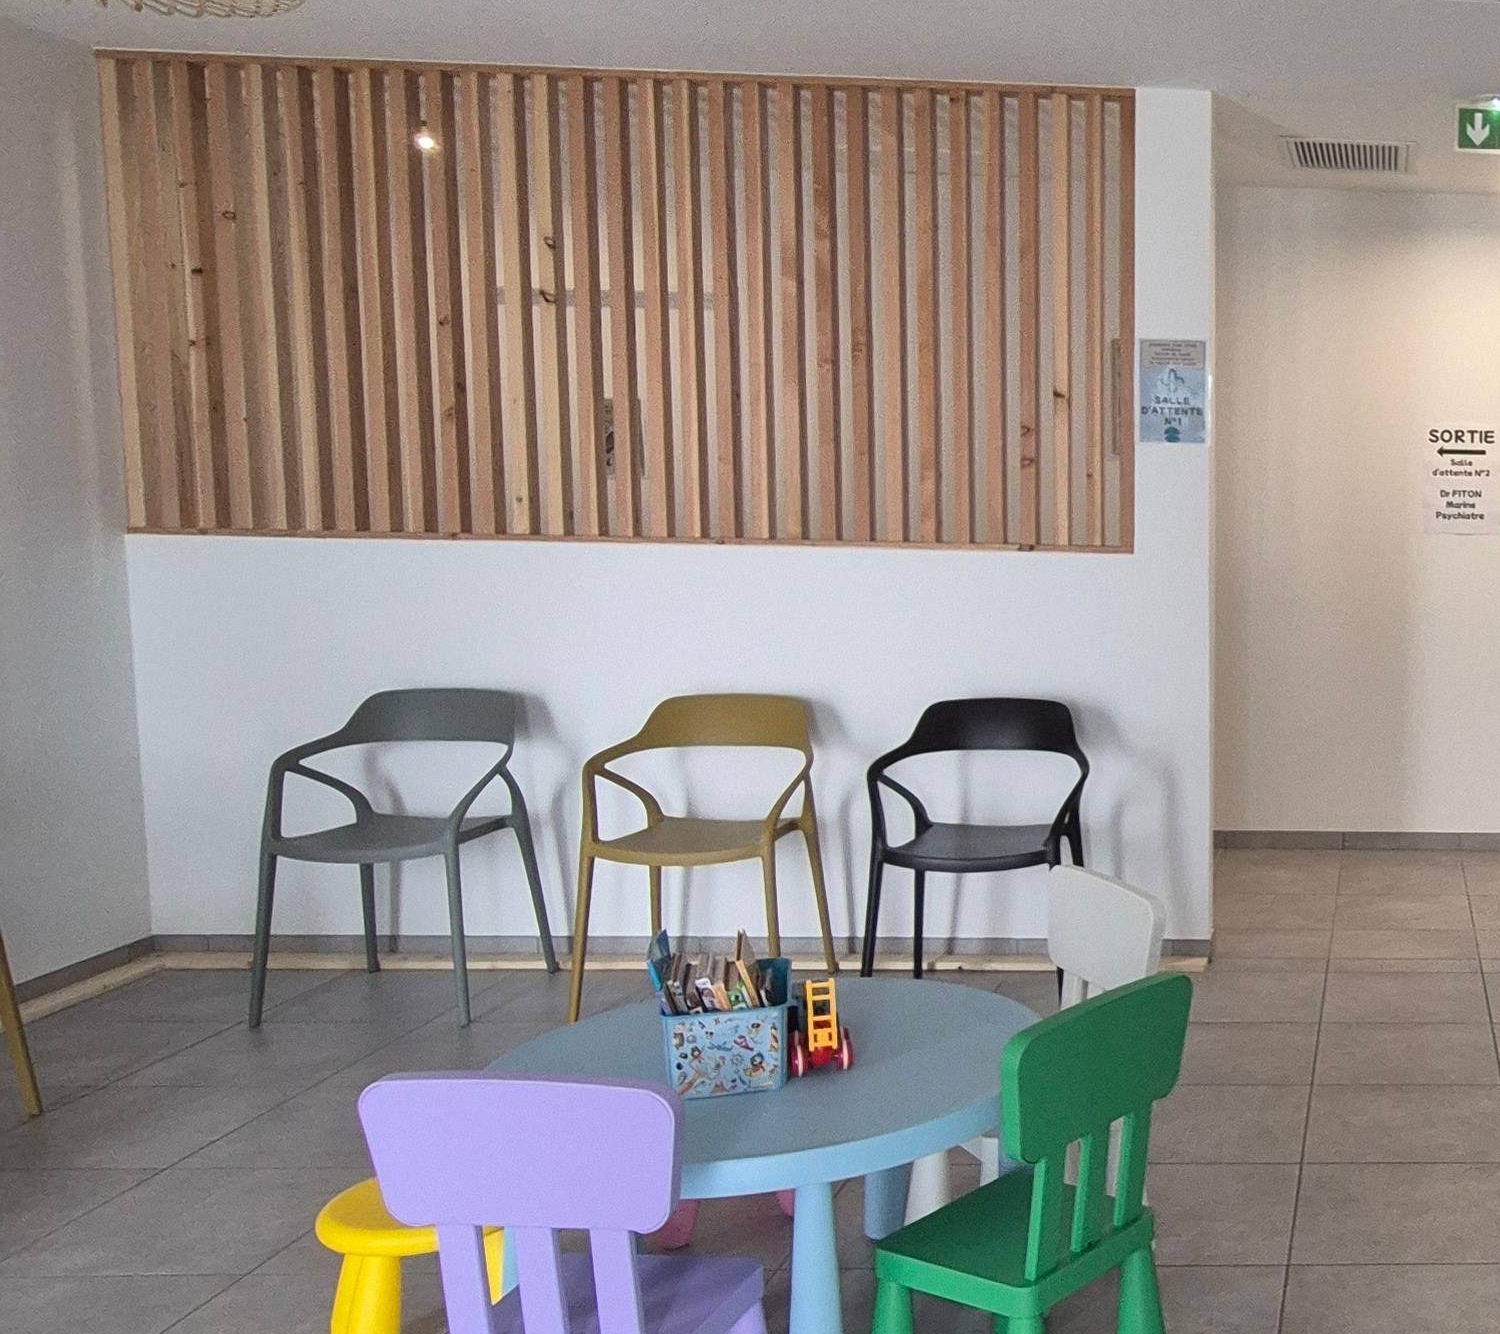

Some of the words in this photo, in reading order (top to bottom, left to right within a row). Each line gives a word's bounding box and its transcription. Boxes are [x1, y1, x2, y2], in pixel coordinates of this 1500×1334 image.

[1154, 395, 1190, 405] SALLE
[1141, 406, 1203, 416] D'ATTENTE
[1164, 417, 1182, 426] N°1
[1428, 429, 1495, 444] SORTIE
[1450, 459, 1473, 467] Salle
[1431, 468, 1473, 477] d'attente
[1474, 469, 1490, 477] N°2
[1440, 489, 1450, 498] Dr
[1445, 501, 1476, 509] Marine
[1435, 511, 1485, 520] Psychiatre
